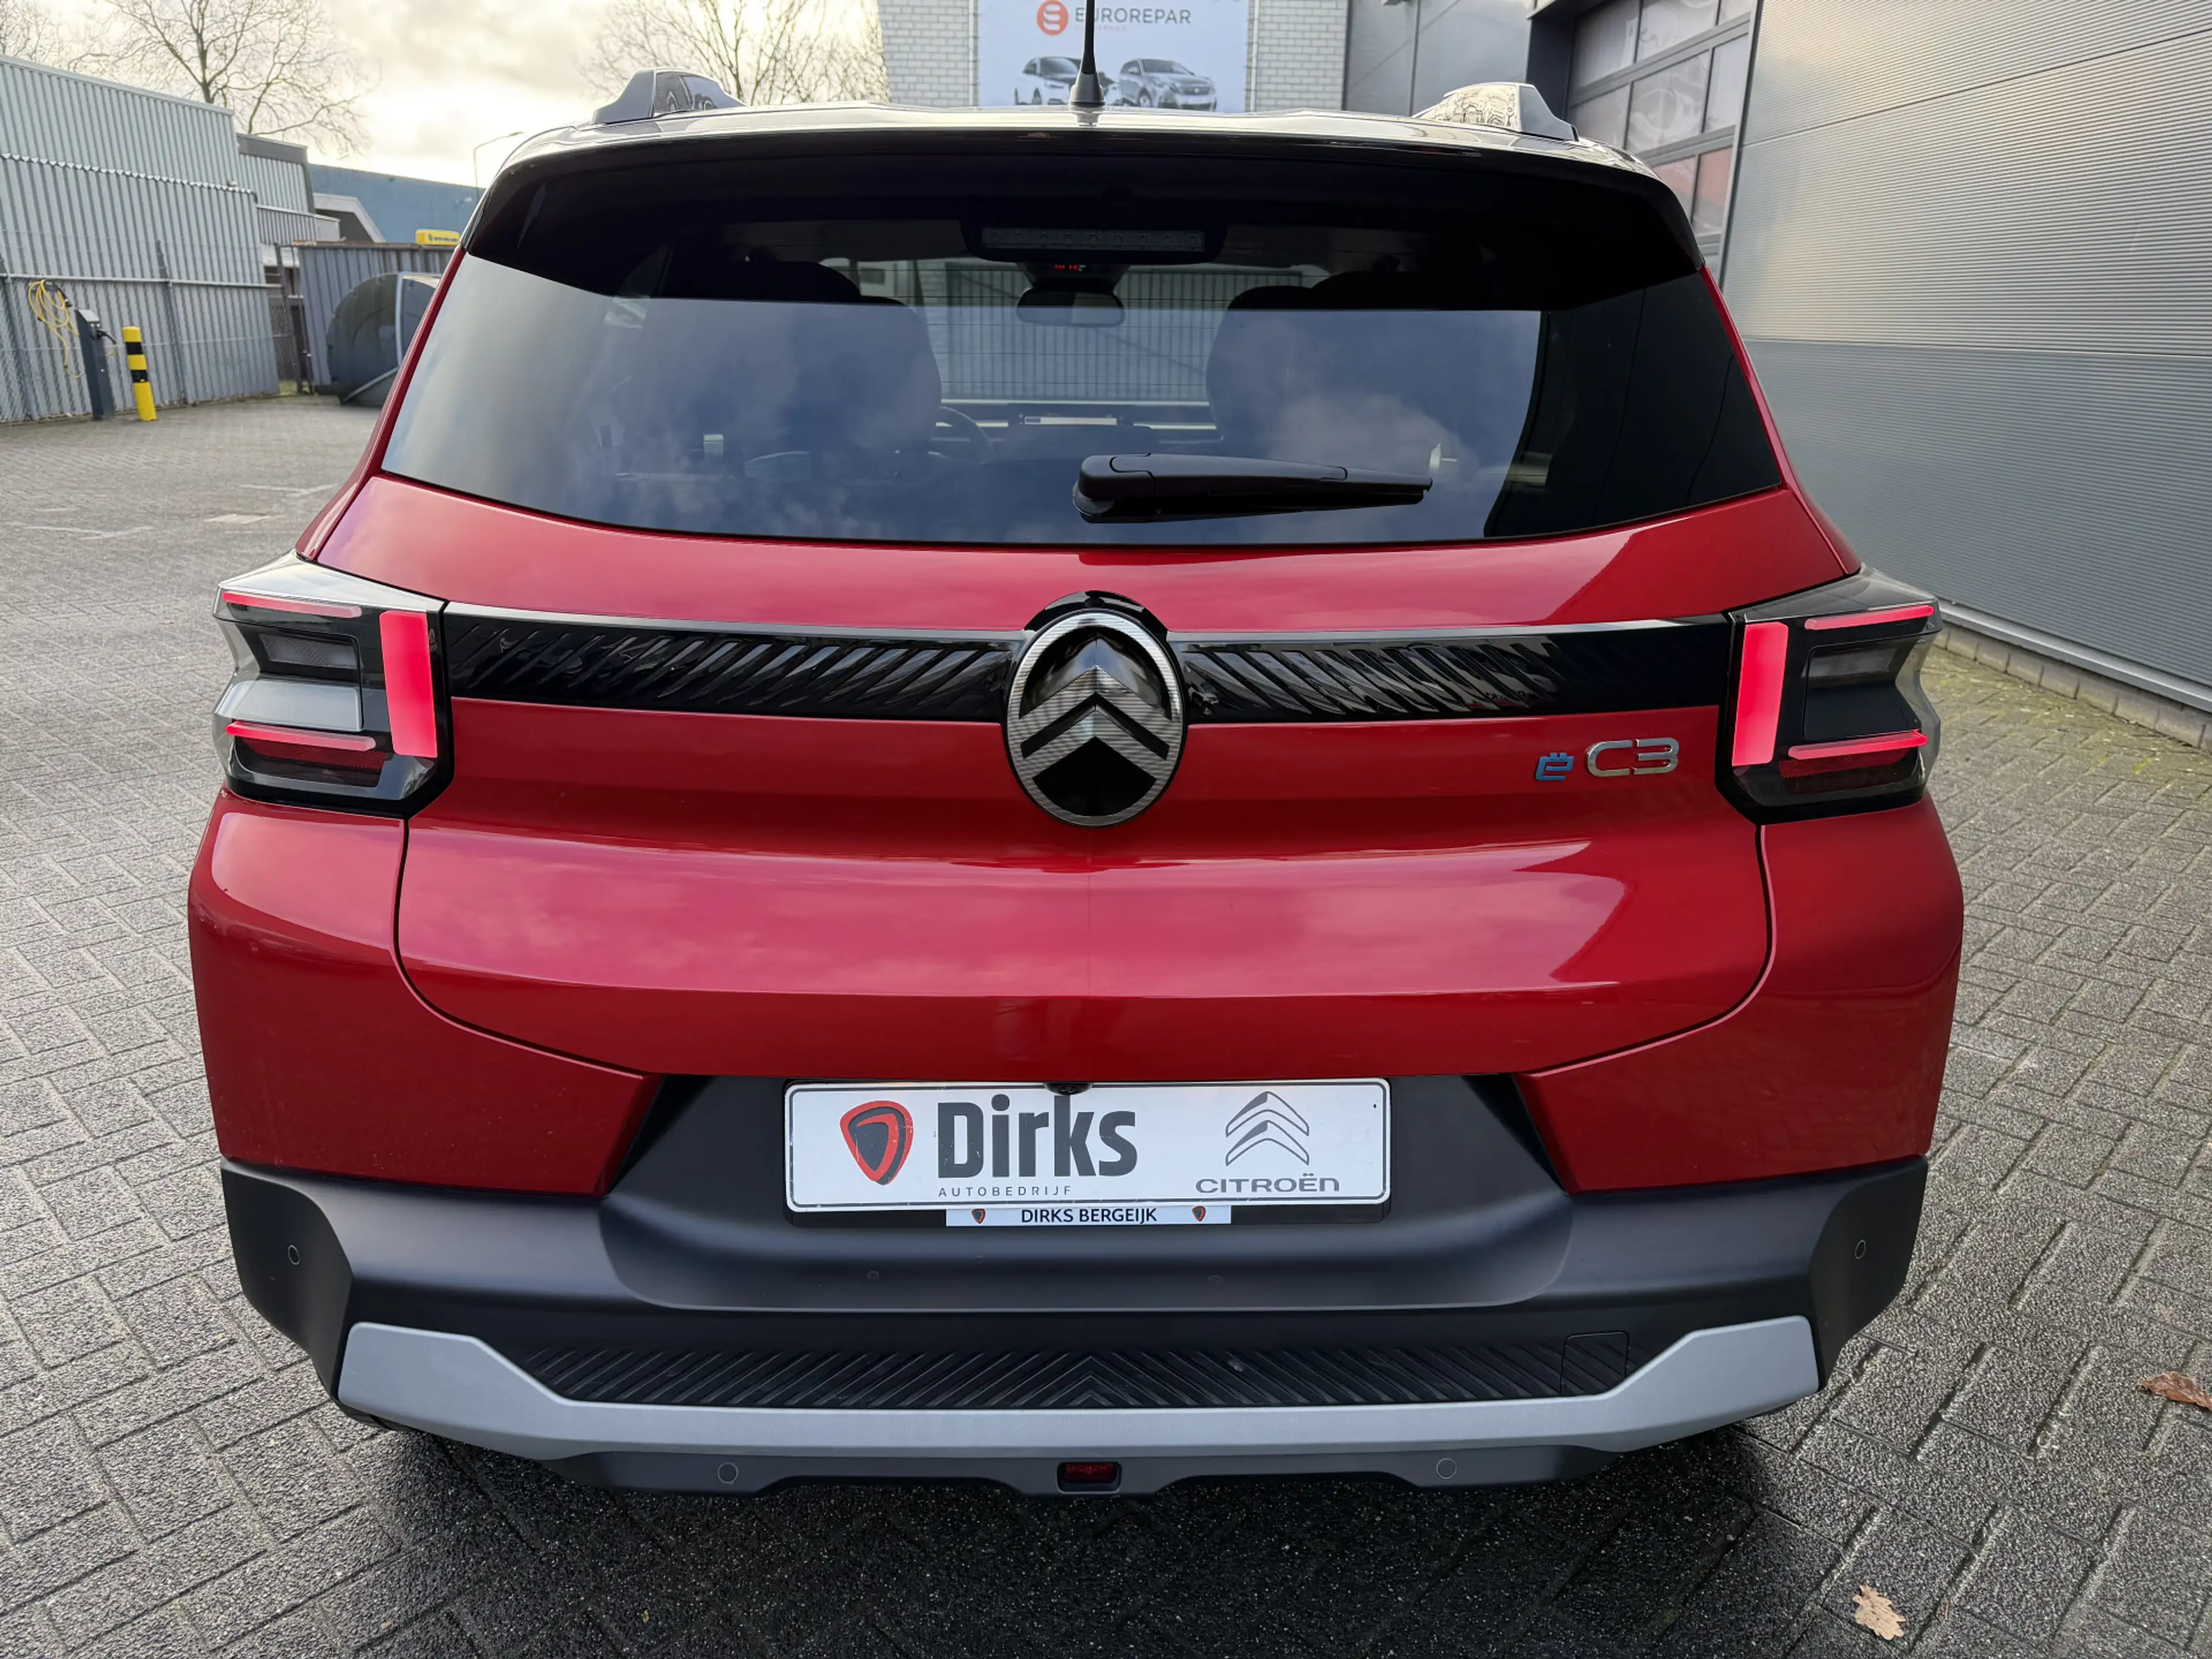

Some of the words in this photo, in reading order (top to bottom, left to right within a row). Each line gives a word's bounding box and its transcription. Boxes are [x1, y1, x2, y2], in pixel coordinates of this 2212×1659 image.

[1585, 737, 1679, 777] C3
[938, 1094, 1138, 1178] Dirks
[938, 1186, 1071, 1197] AUTOBEDRIJF
[1021, 1209, 1074, 1222] DIRKS
[1080, 1207, 1157, 1225] BERGEIJK
